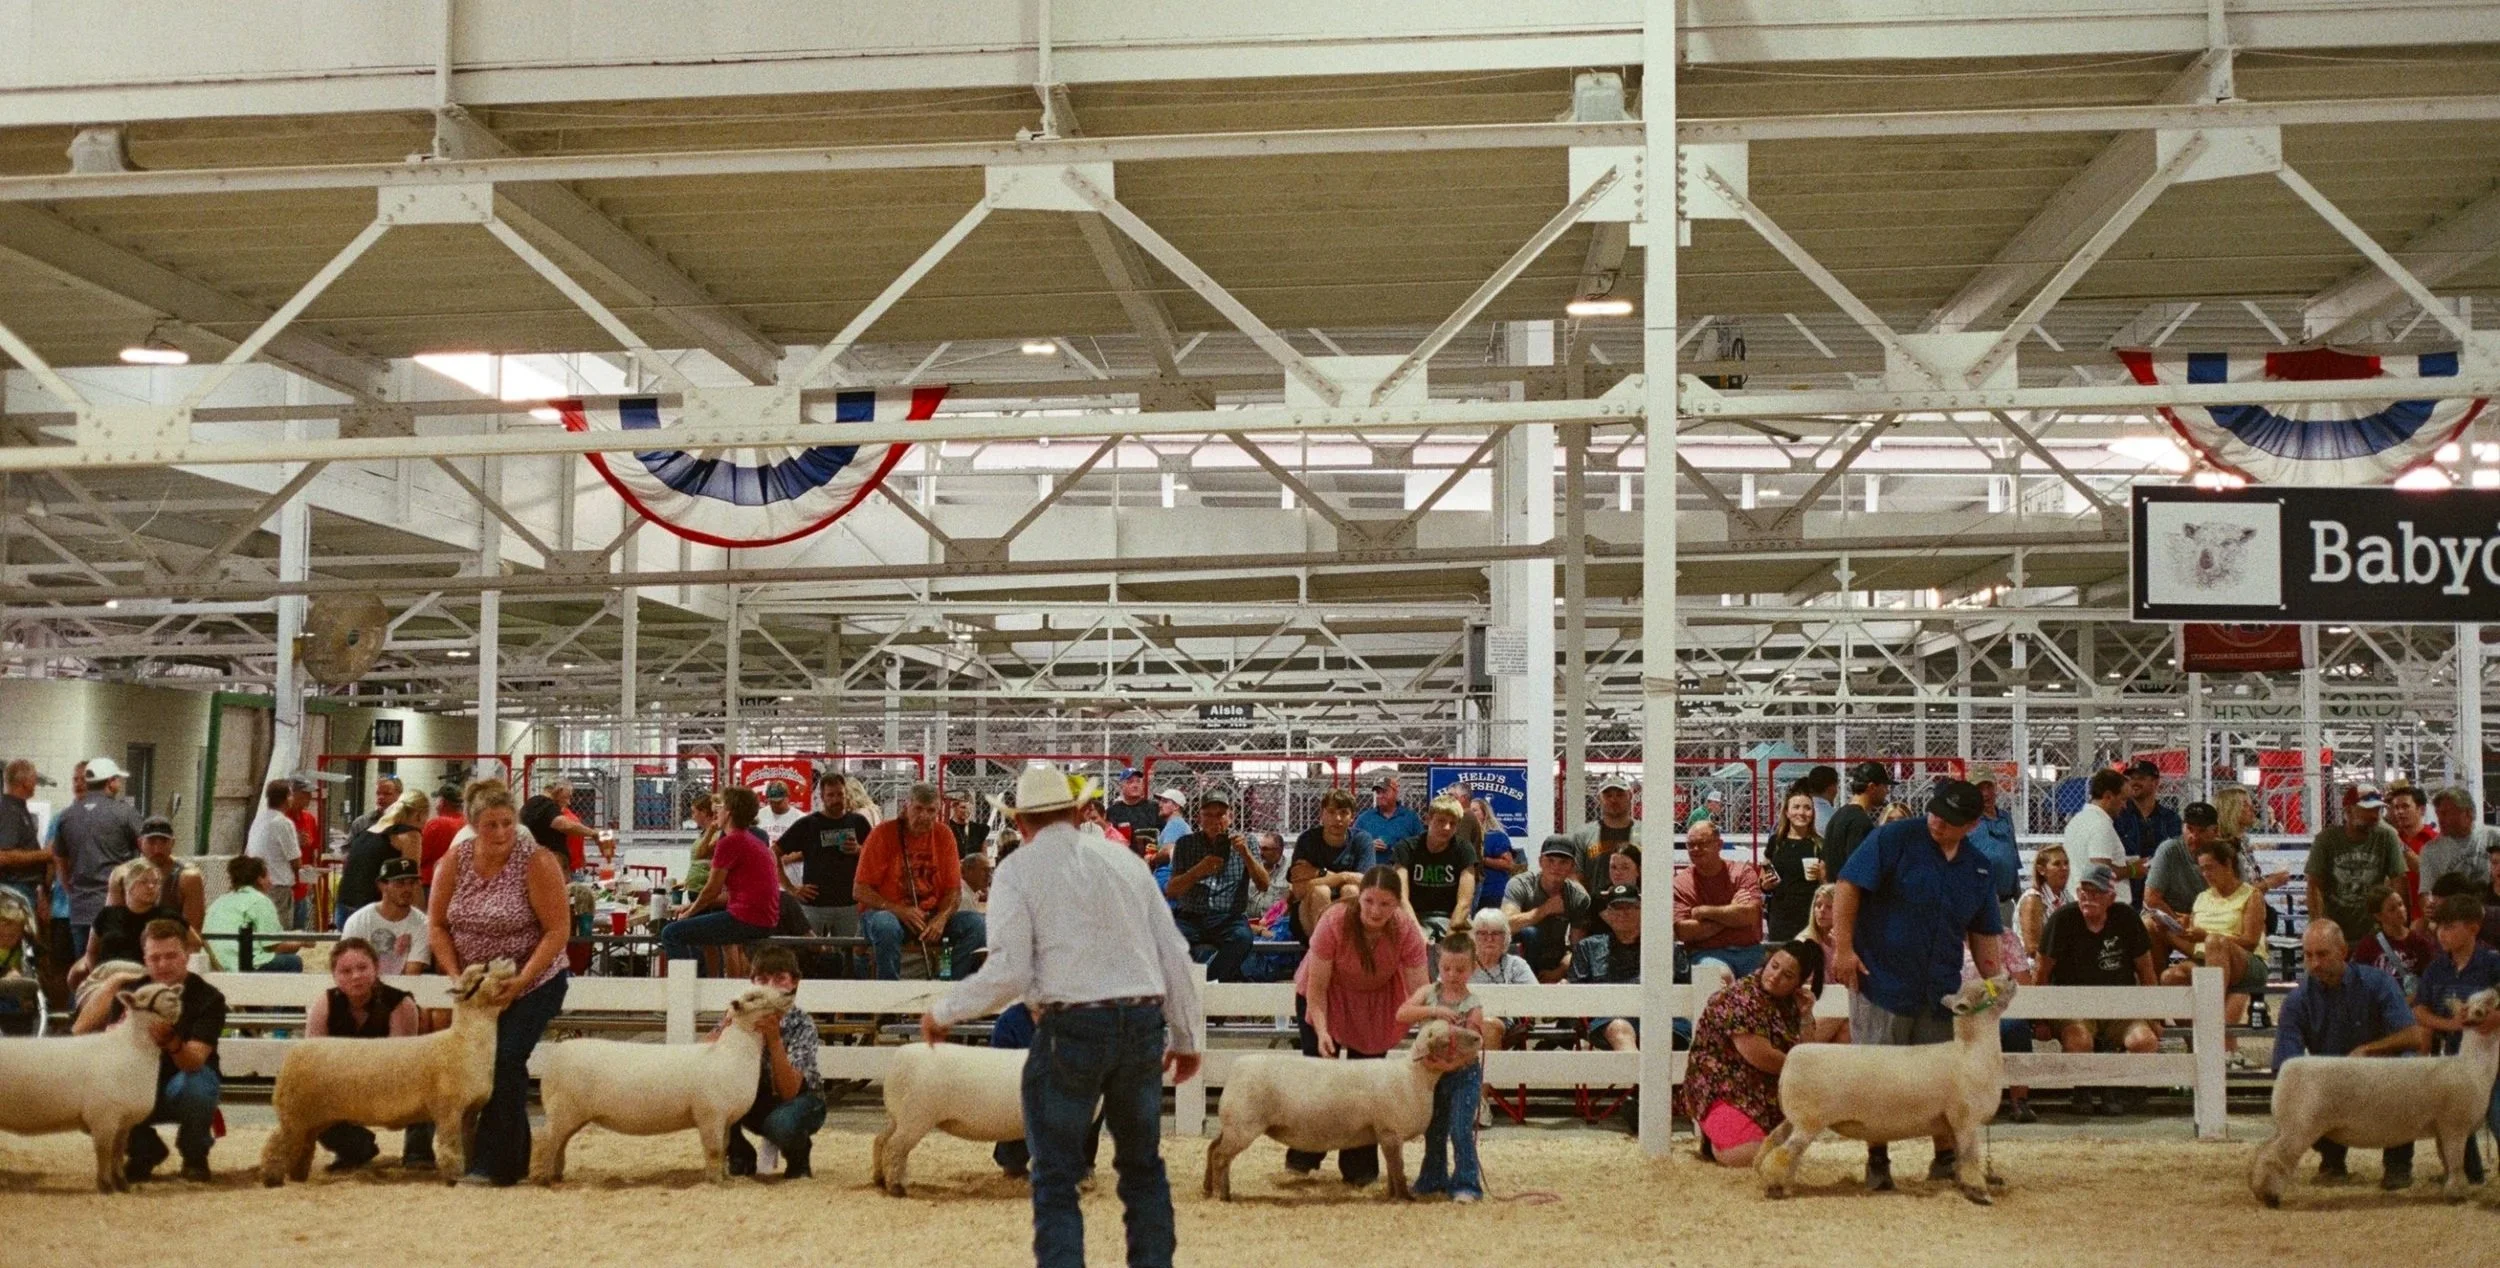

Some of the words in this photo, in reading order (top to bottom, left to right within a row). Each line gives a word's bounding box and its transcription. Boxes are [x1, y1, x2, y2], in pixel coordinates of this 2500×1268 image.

[1209, 704, 1244, 715] Aisle
[2260, 692, 2396, 716] OORD
[1457, 772, 1506, 784] HELD'S
[1436, 782, 1525, 801] HPSHIRES
